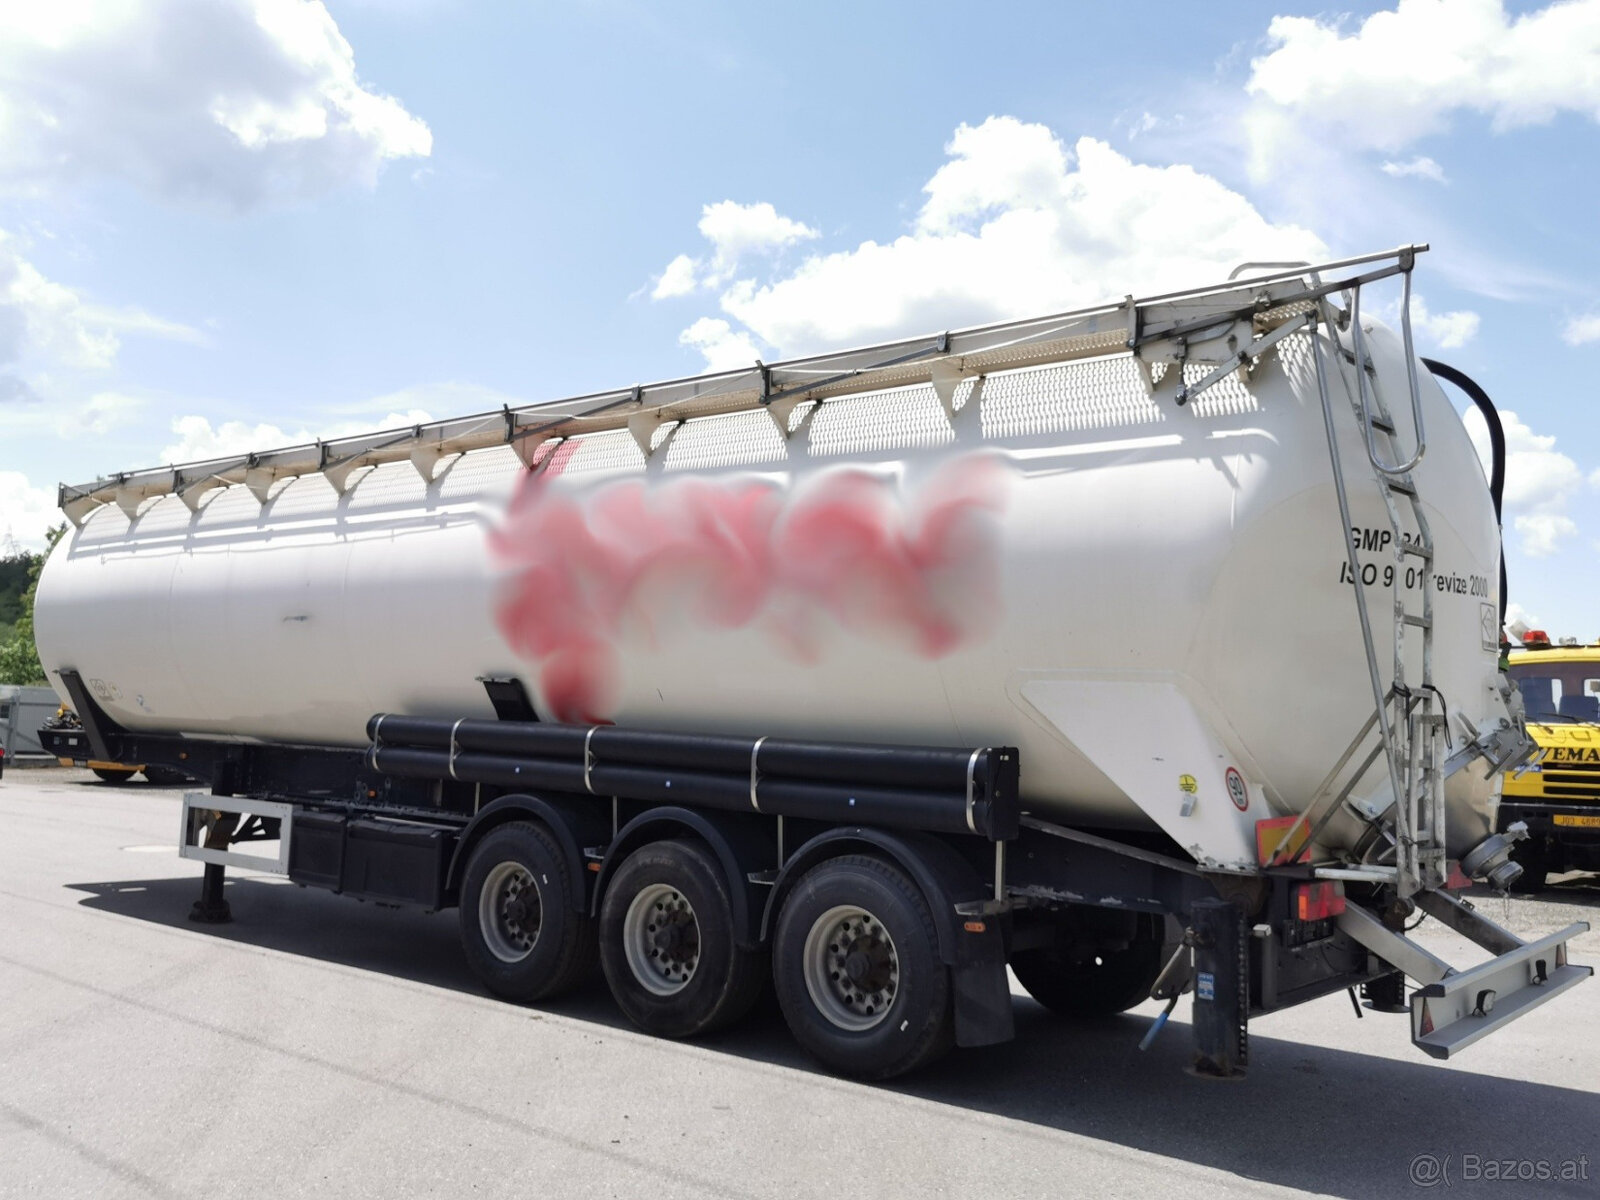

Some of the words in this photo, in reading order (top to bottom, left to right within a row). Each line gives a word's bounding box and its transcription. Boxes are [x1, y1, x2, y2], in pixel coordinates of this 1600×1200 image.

[1351, 527, 1391, 552] GMP
[1340, 562, 1377, 586] ISO
[1383, 565, 1424, 590] 901
[1470, 574, 1488, 598] 2000
